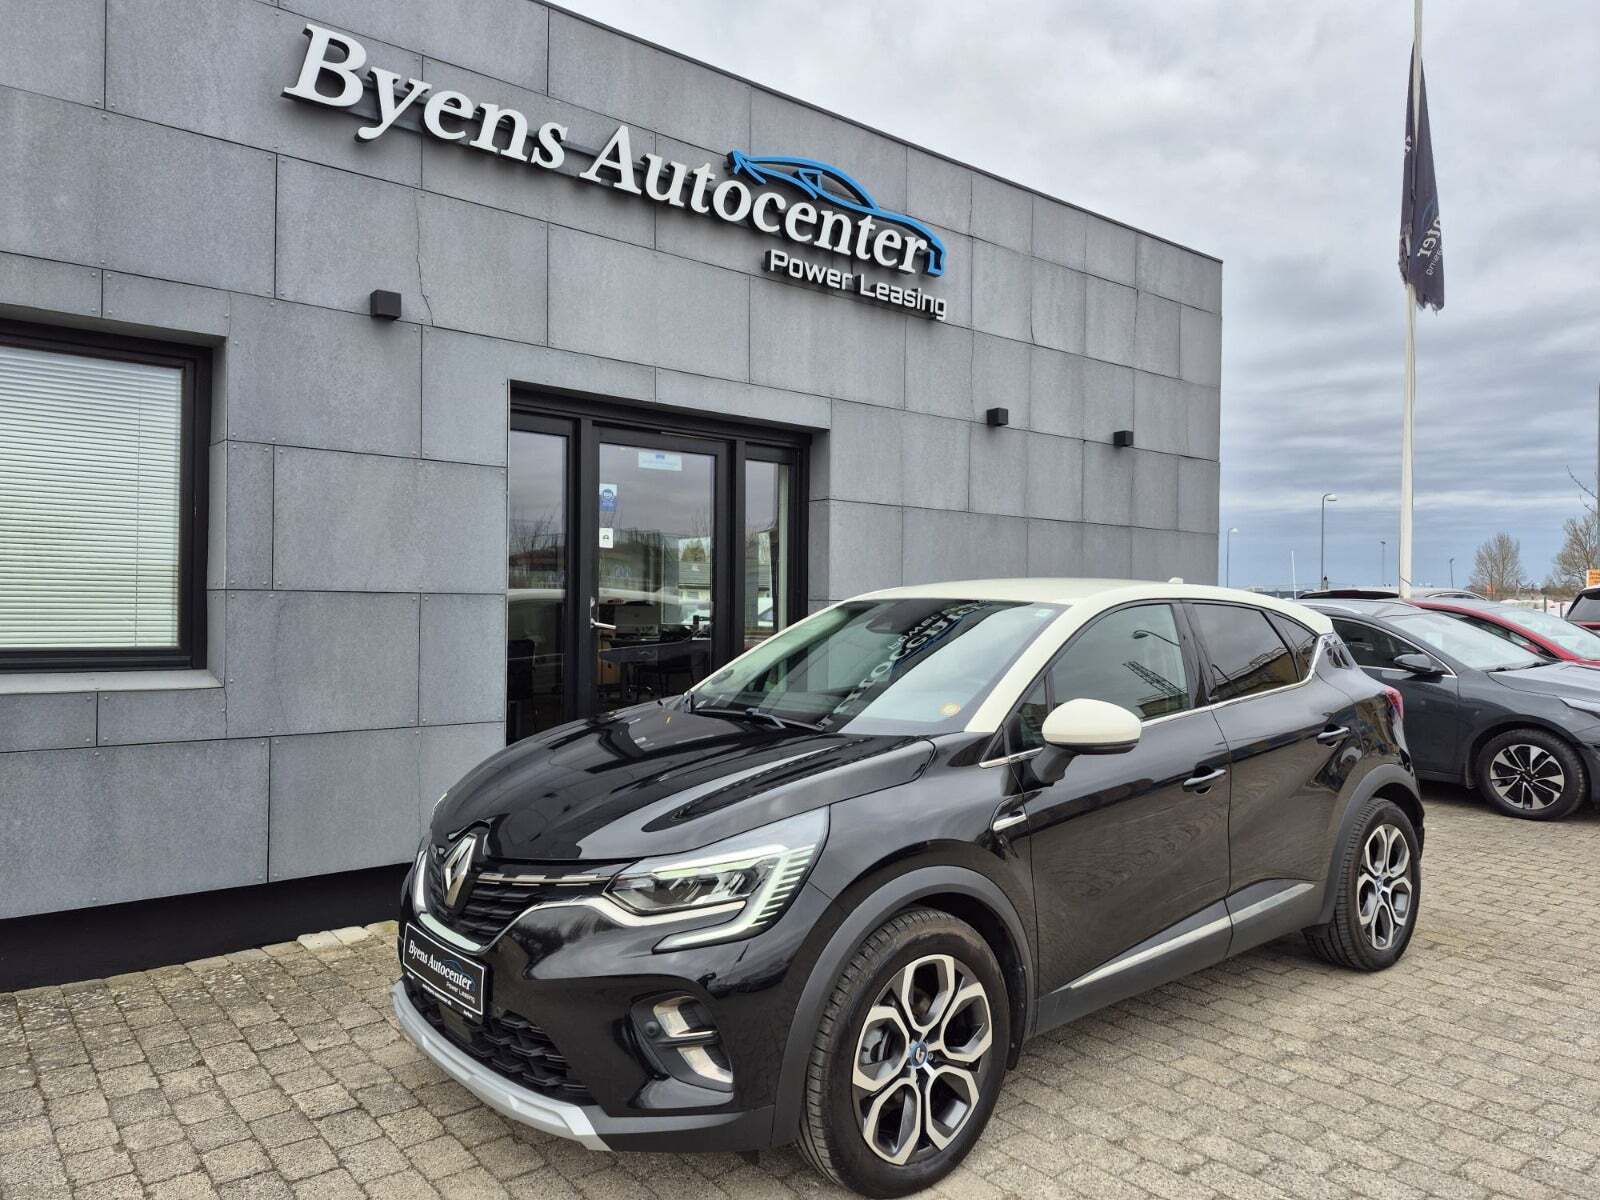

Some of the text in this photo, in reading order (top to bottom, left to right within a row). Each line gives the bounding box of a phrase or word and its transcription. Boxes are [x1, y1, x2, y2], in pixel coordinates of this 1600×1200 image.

[283, 23, 928, 274] Byens Autocenter
[769, 249, 948, 321] Power Leasing
[409, 940, 472, 990] Byens Autocenter
